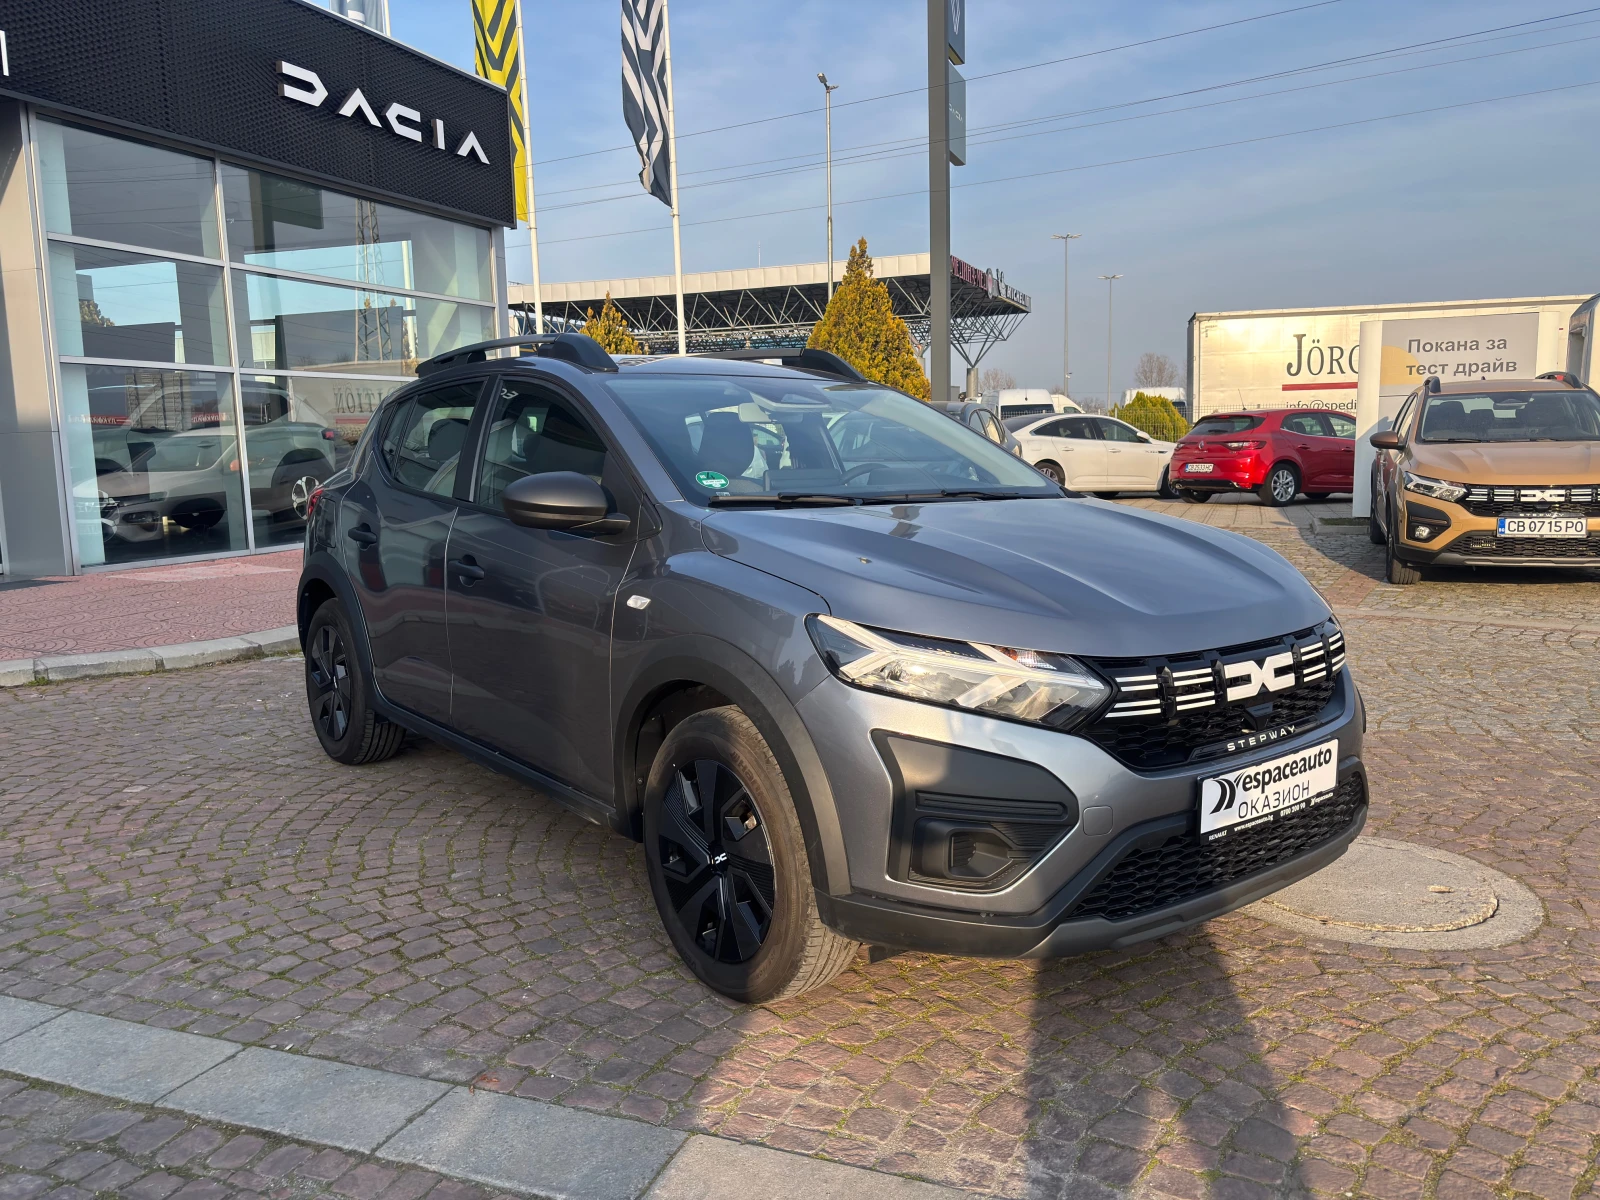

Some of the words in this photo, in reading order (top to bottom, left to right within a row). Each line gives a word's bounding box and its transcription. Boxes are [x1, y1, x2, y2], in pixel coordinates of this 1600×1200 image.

[276, 60, 490, 165] DACIA
[1408, 339, 1480, 353] Покана
[1486, 338, 1507, 350] за
[1406, 364, 1448, 376] тест
[1454, 358, 1517, 377] драйв
[1507, 521, 1526, 533] CB
[1528, 520, 1562, 533] 0715
[1565, 521, 1584, 533] PO
[1227, 725, 1295, 751] STEPWAY
[1242, 747, 1332, 794] espaceauto
[1238, 780, 1310, 819] ОКАЗИОН
[1208, 829, 1227, 841] RENAULT
